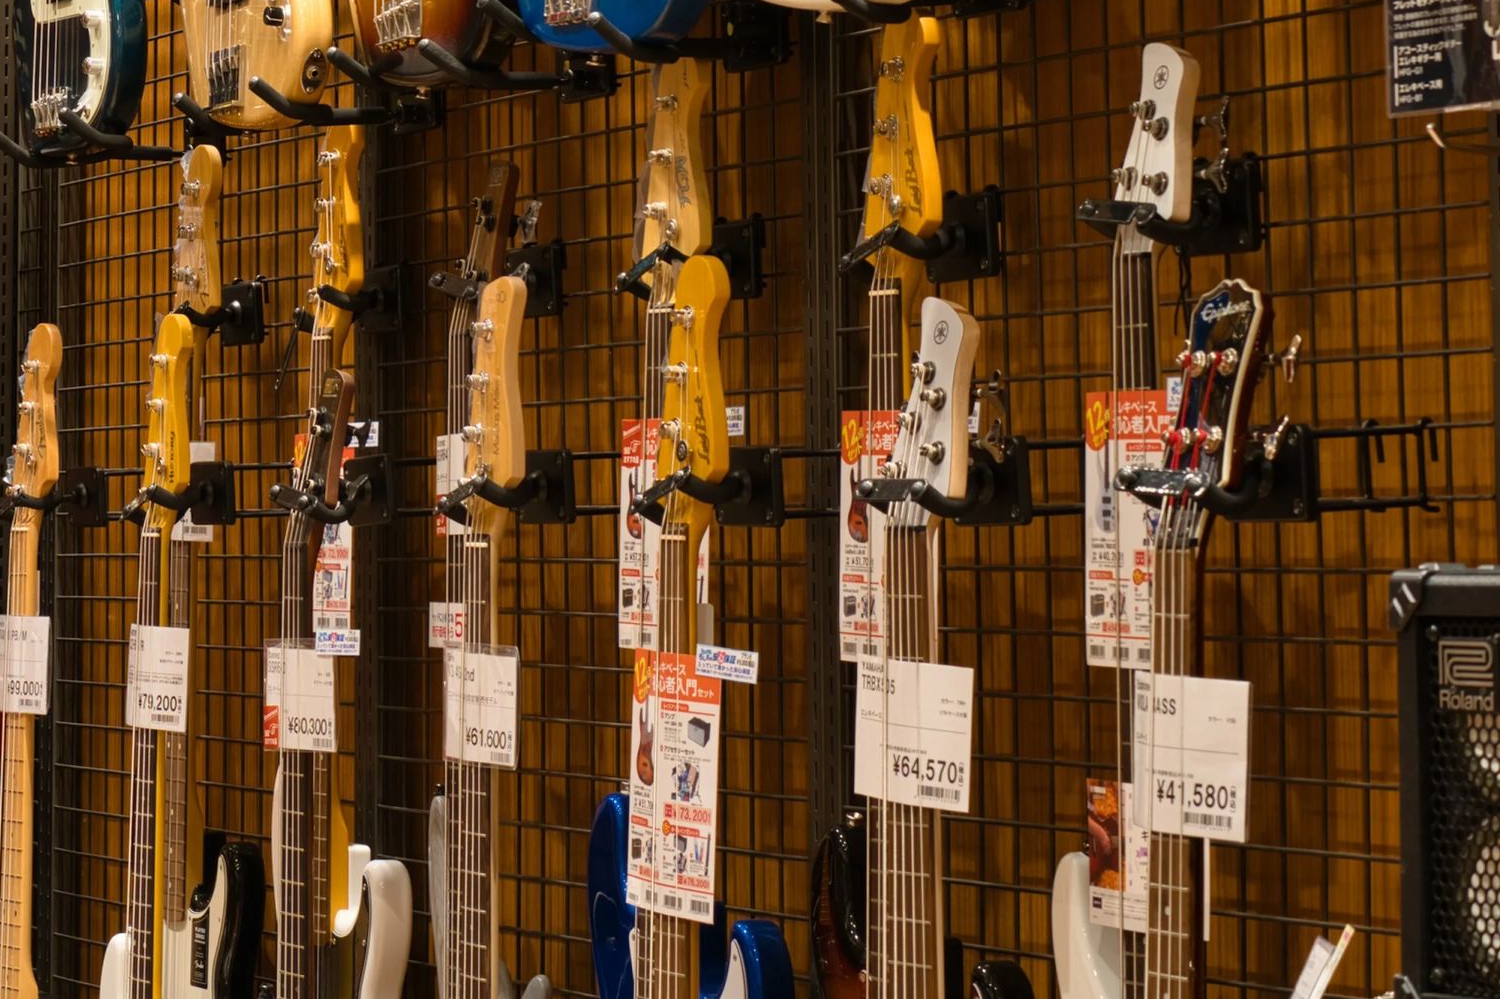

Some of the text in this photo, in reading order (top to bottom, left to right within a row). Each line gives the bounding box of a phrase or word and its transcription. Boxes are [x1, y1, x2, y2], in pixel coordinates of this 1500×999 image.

[138, 693, 178, 712] ¥79,200
[1153, 696, 1176, 715] ASS
[1439, 689, 1494, 712] Roland
[288, 716, 328, 736] ¥80,300
[466, 727, 506, 750] ¥61,600
[893, 753, 957, 784] ¥64,570
[1157, 779, 1229, 810] ¥41,580
